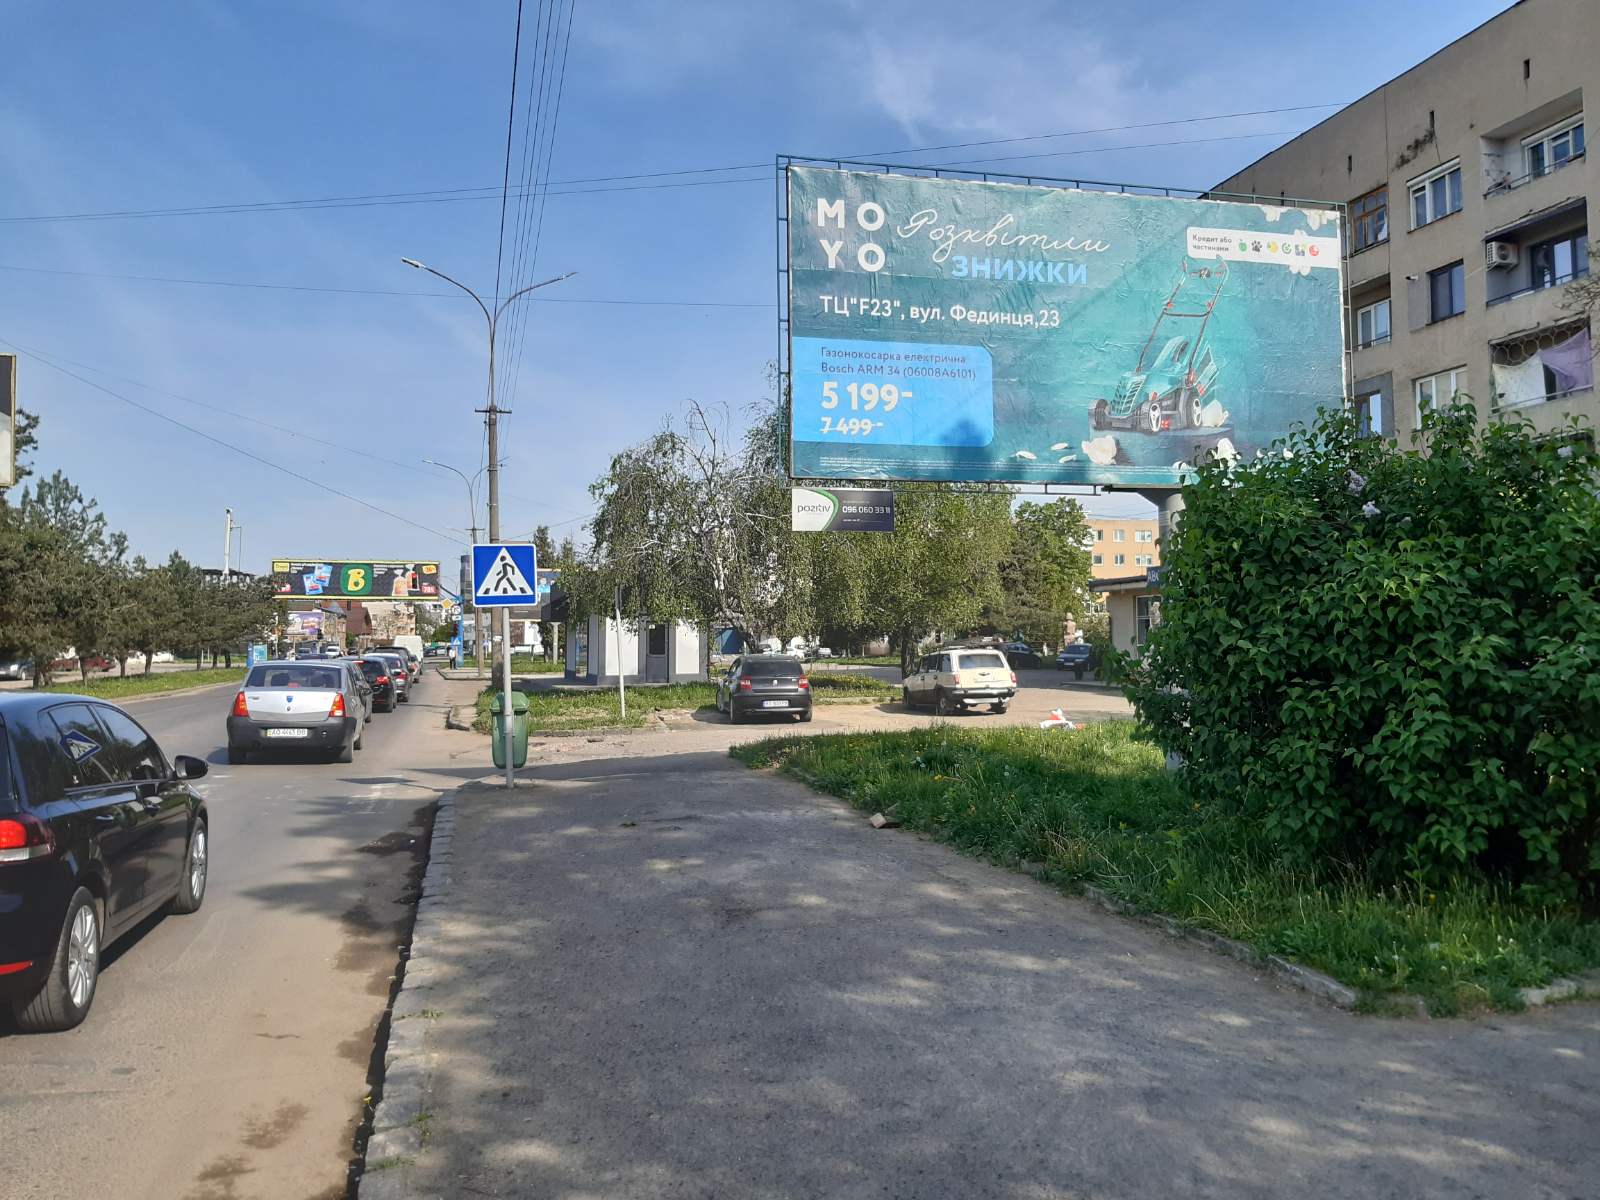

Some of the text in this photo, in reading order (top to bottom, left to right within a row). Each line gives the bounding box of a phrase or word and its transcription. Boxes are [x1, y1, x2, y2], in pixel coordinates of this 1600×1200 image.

[1192, 233, 1232, 244] Кредит або
[1192, 244, 1229, 252] частинами
[951, 255, 1089, 285] ЗНИЖКИ
[909, 306, 945, 323] вул.
[820, 347, 967, 367] Газонокосарка електрична
[820, 361, 854, 375] Bosch
[857, 364, 885, 376] ARM
[886, 365, 901, 377] 34
[797, 503, 831, 513] pozitiv
